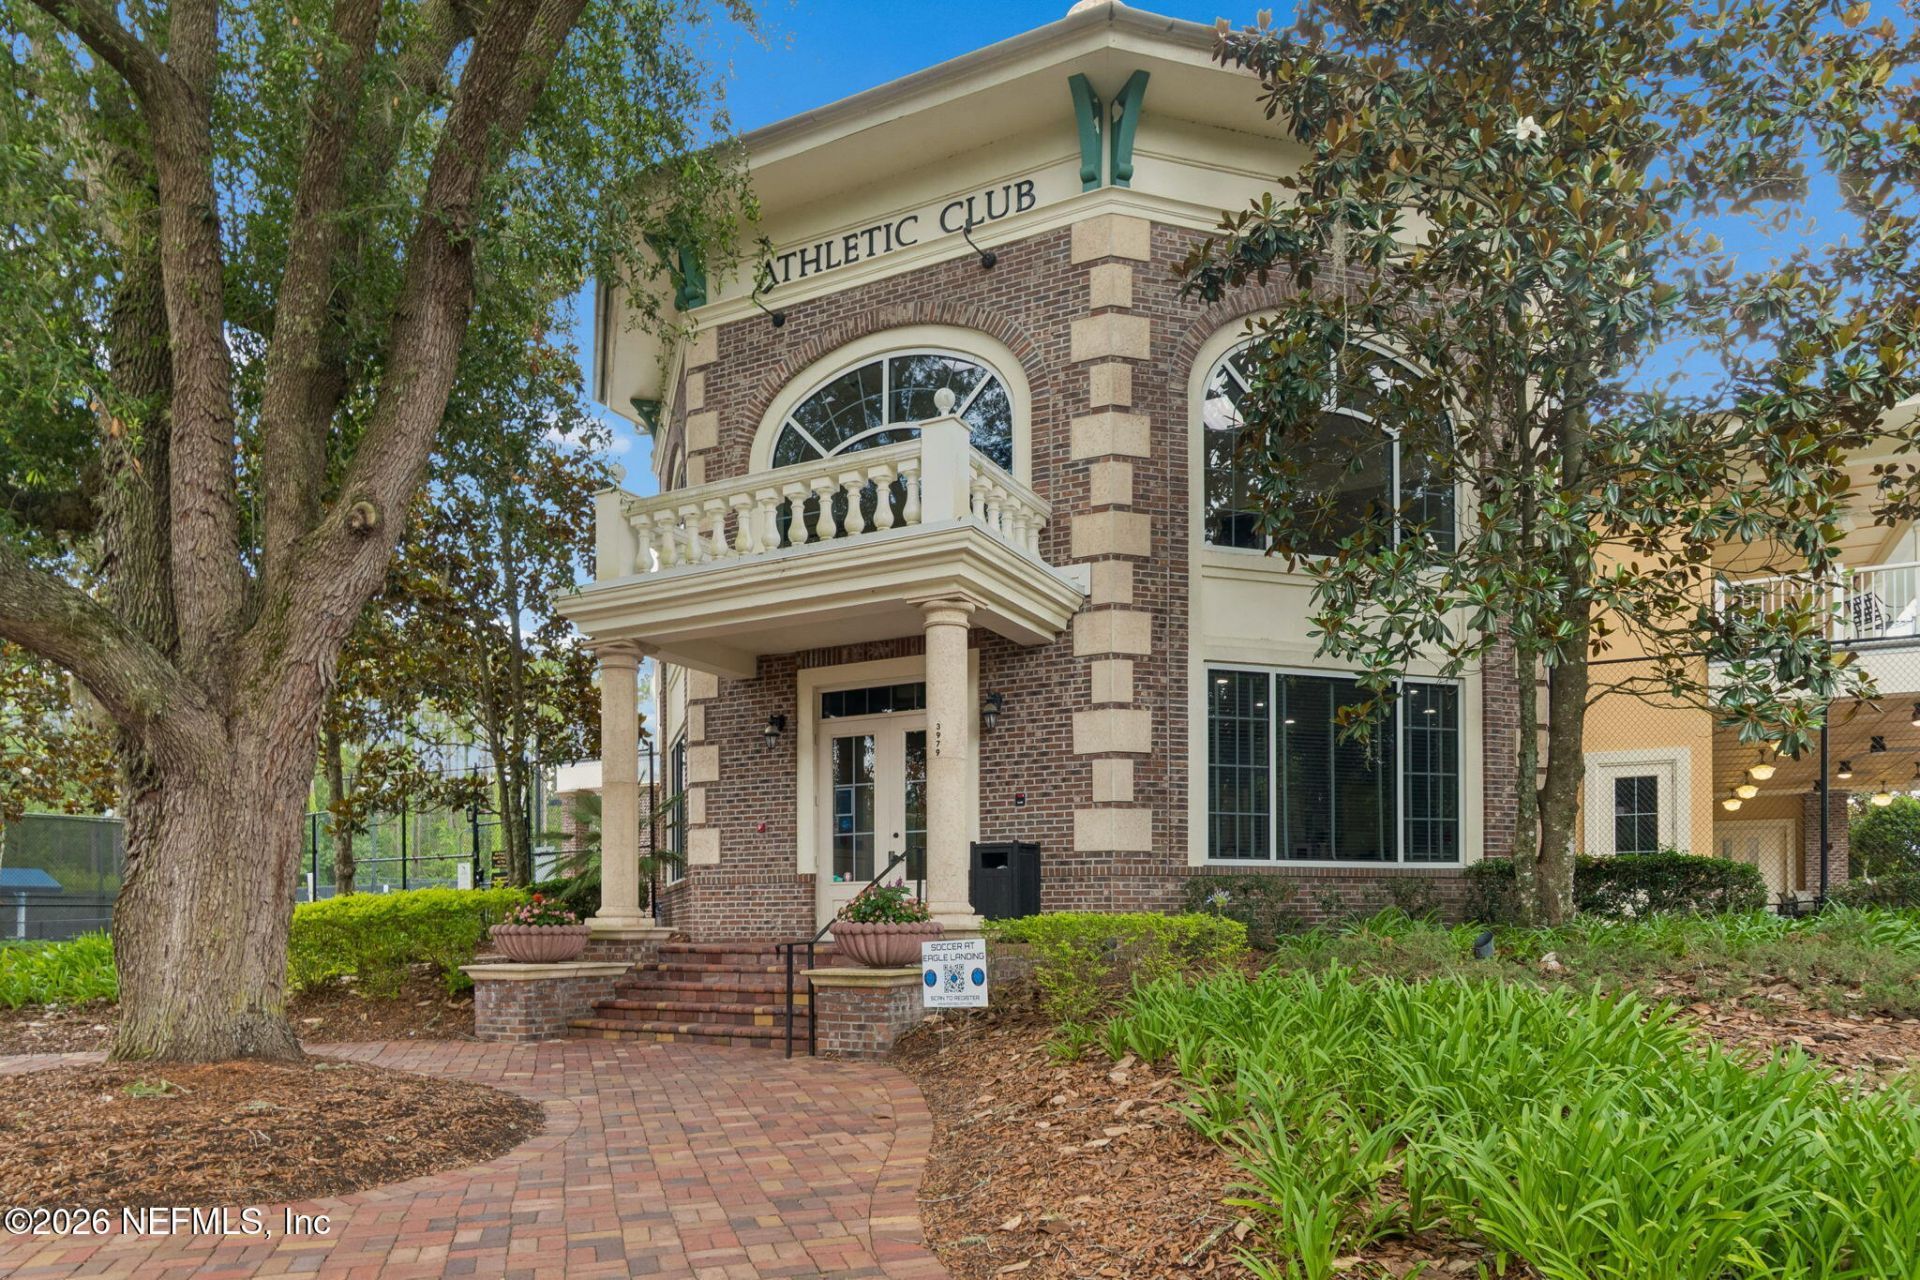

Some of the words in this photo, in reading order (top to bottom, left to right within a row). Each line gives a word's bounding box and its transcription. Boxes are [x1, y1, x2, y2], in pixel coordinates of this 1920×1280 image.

[939, 179, 1037, 234] CLUB
[930, 942, 963, 952] SOCCER
[964, 941, 975, 950] AT
[922, 953, 948, 962] EAGLE
[950, 952, 985, 961] LANDING
